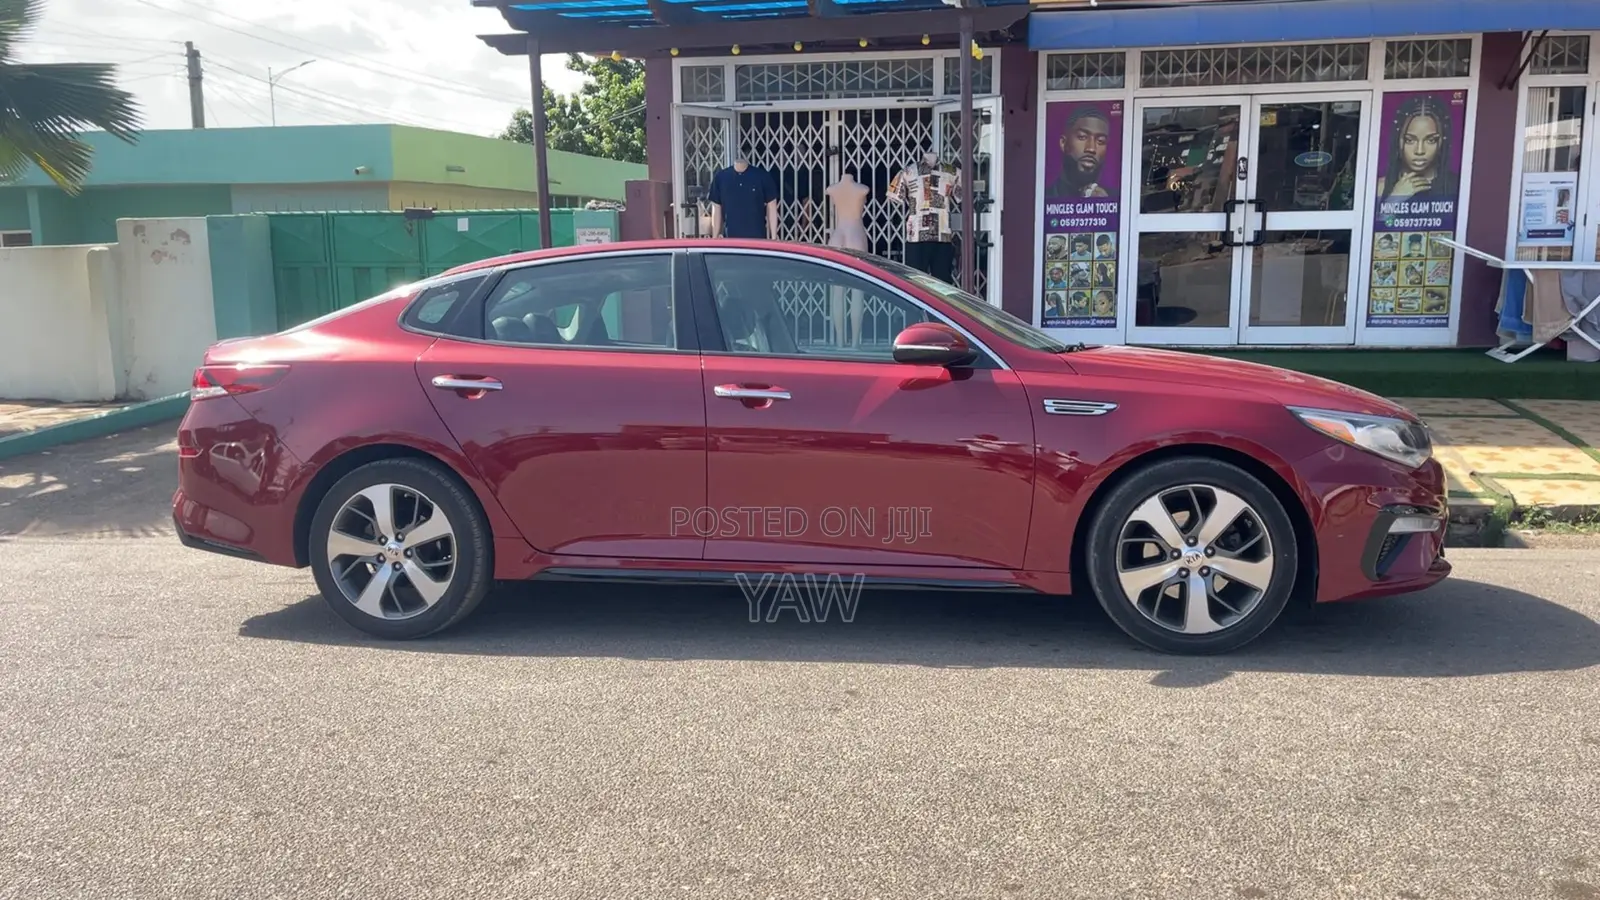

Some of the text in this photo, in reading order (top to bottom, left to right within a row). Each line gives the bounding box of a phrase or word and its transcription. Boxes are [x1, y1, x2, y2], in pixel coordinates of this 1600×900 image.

[1046, 202, 1118, 214] MINGLES GLAM TOUCH
[1380, 201, 1454, 214] MINGLES GLAM TOUCH
[1060, 218, 1107, 227] 0597377310
[1393, 218, 1442, 227] 0597377310
[1185, 553, 1200, 565] KIA
